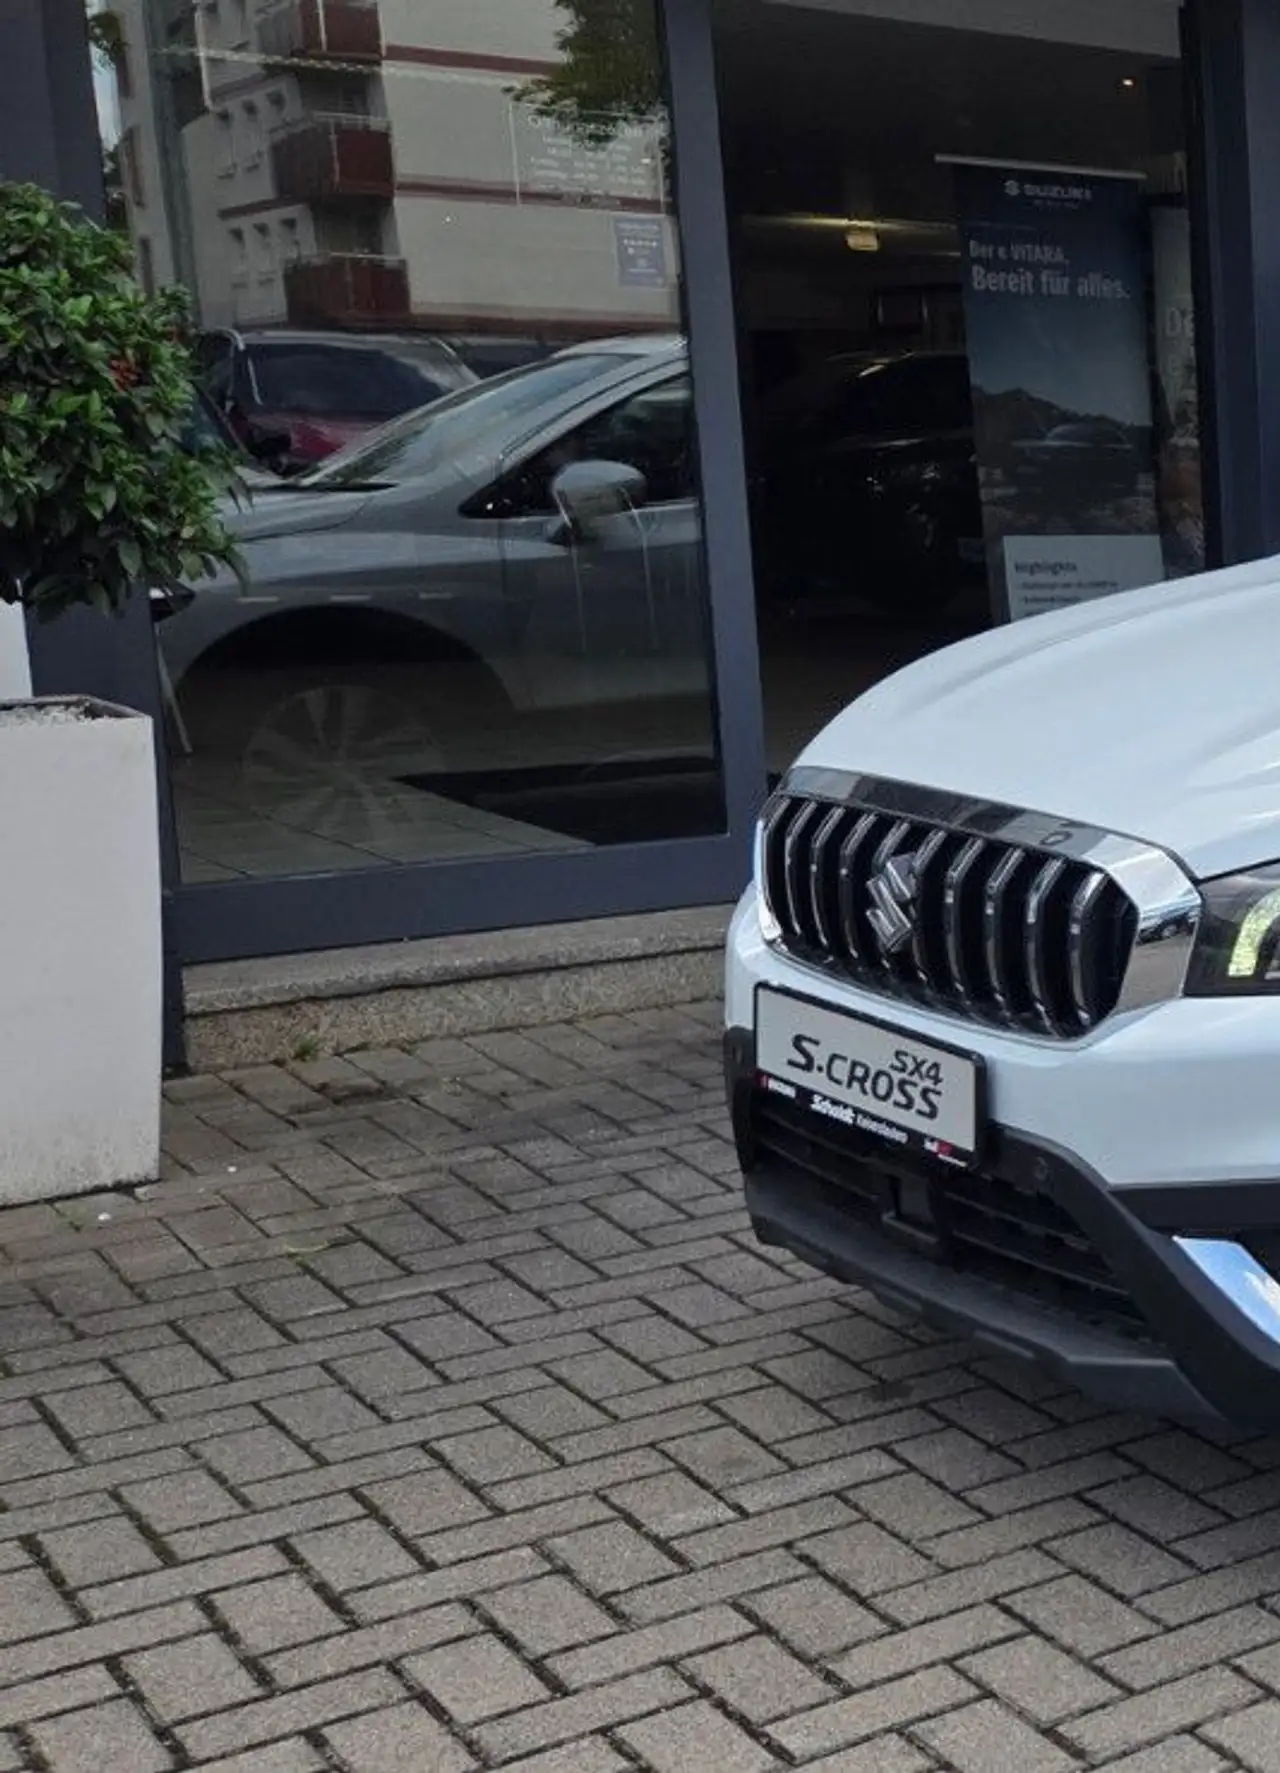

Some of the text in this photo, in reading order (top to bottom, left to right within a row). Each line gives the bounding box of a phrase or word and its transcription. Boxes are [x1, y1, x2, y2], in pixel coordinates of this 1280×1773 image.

[971, 265, 1131, 299] Bereit für alles.
[889, 1049, 943, 1086] SX4
